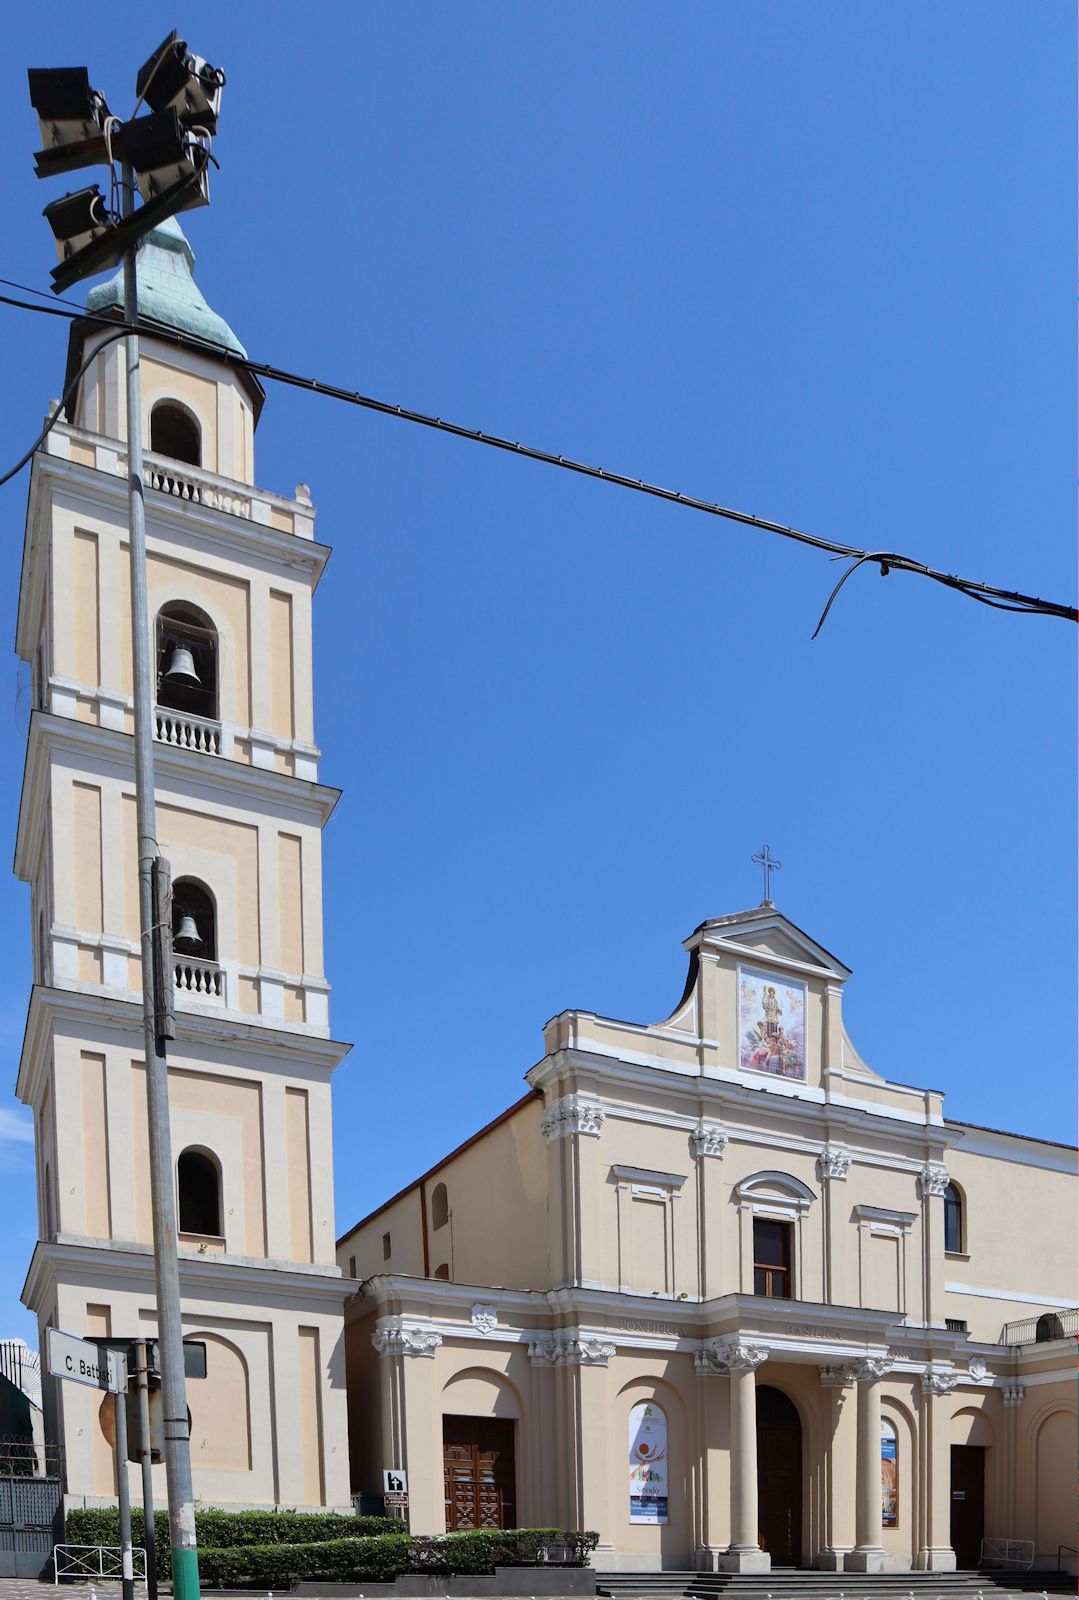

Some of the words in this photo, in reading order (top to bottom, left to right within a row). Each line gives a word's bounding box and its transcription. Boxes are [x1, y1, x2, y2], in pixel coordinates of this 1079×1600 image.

[619, 1319, 688, 1337] PONTIFICIA
[65, 1355, 76, 1373] C.
[79, 1359, 113, 1384] Battisti
[636, 1485, 660, 1494] Snodo
